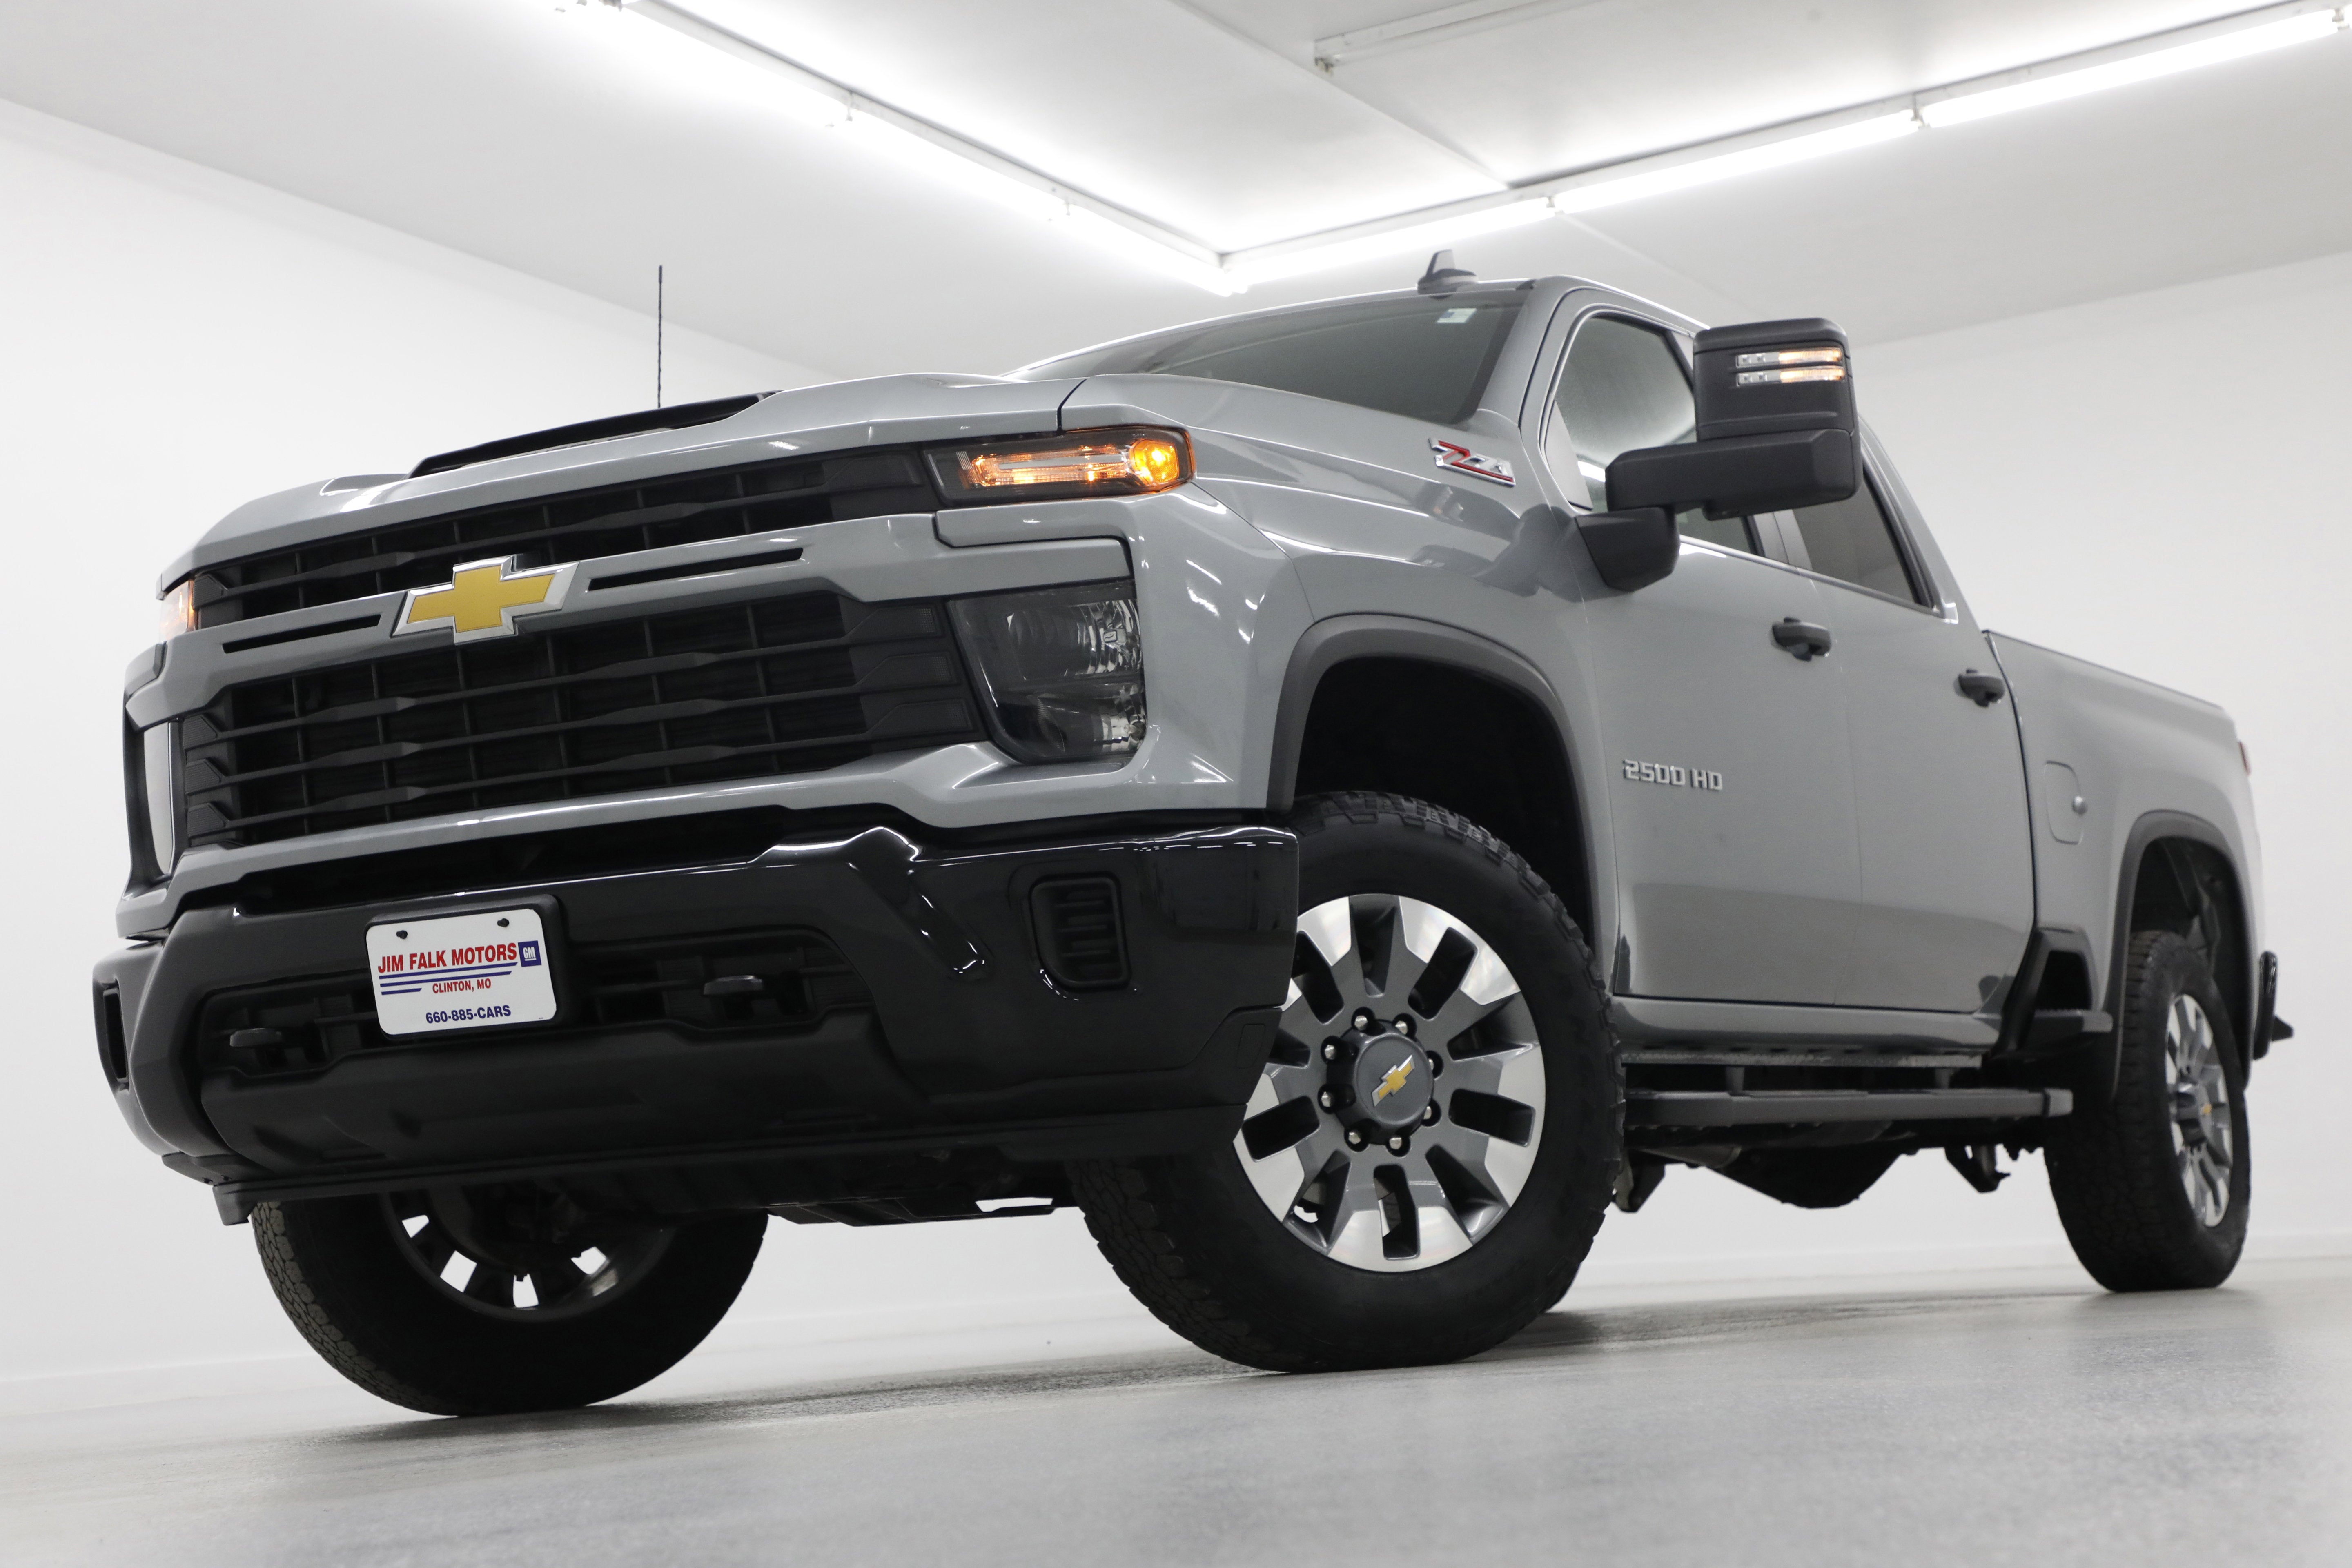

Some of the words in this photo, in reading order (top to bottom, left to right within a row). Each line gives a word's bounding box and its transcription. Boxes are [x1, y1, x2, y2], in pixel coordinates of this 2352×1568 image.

[1623, 759, 1686, 786] 2500
[1690, 768, 1723, 791] HD
[378, 955, 403, 973] JIM
[410, 950, 447, 970] FALK
[451, 943, 517, 965] MOTORS
[523, 947, 536, 960] GM
[432, 980, 474, 993] CLINTON,
[477, 978, 491, 989] MO
[426, 1005, 511, 1023] 660-885-CARS
